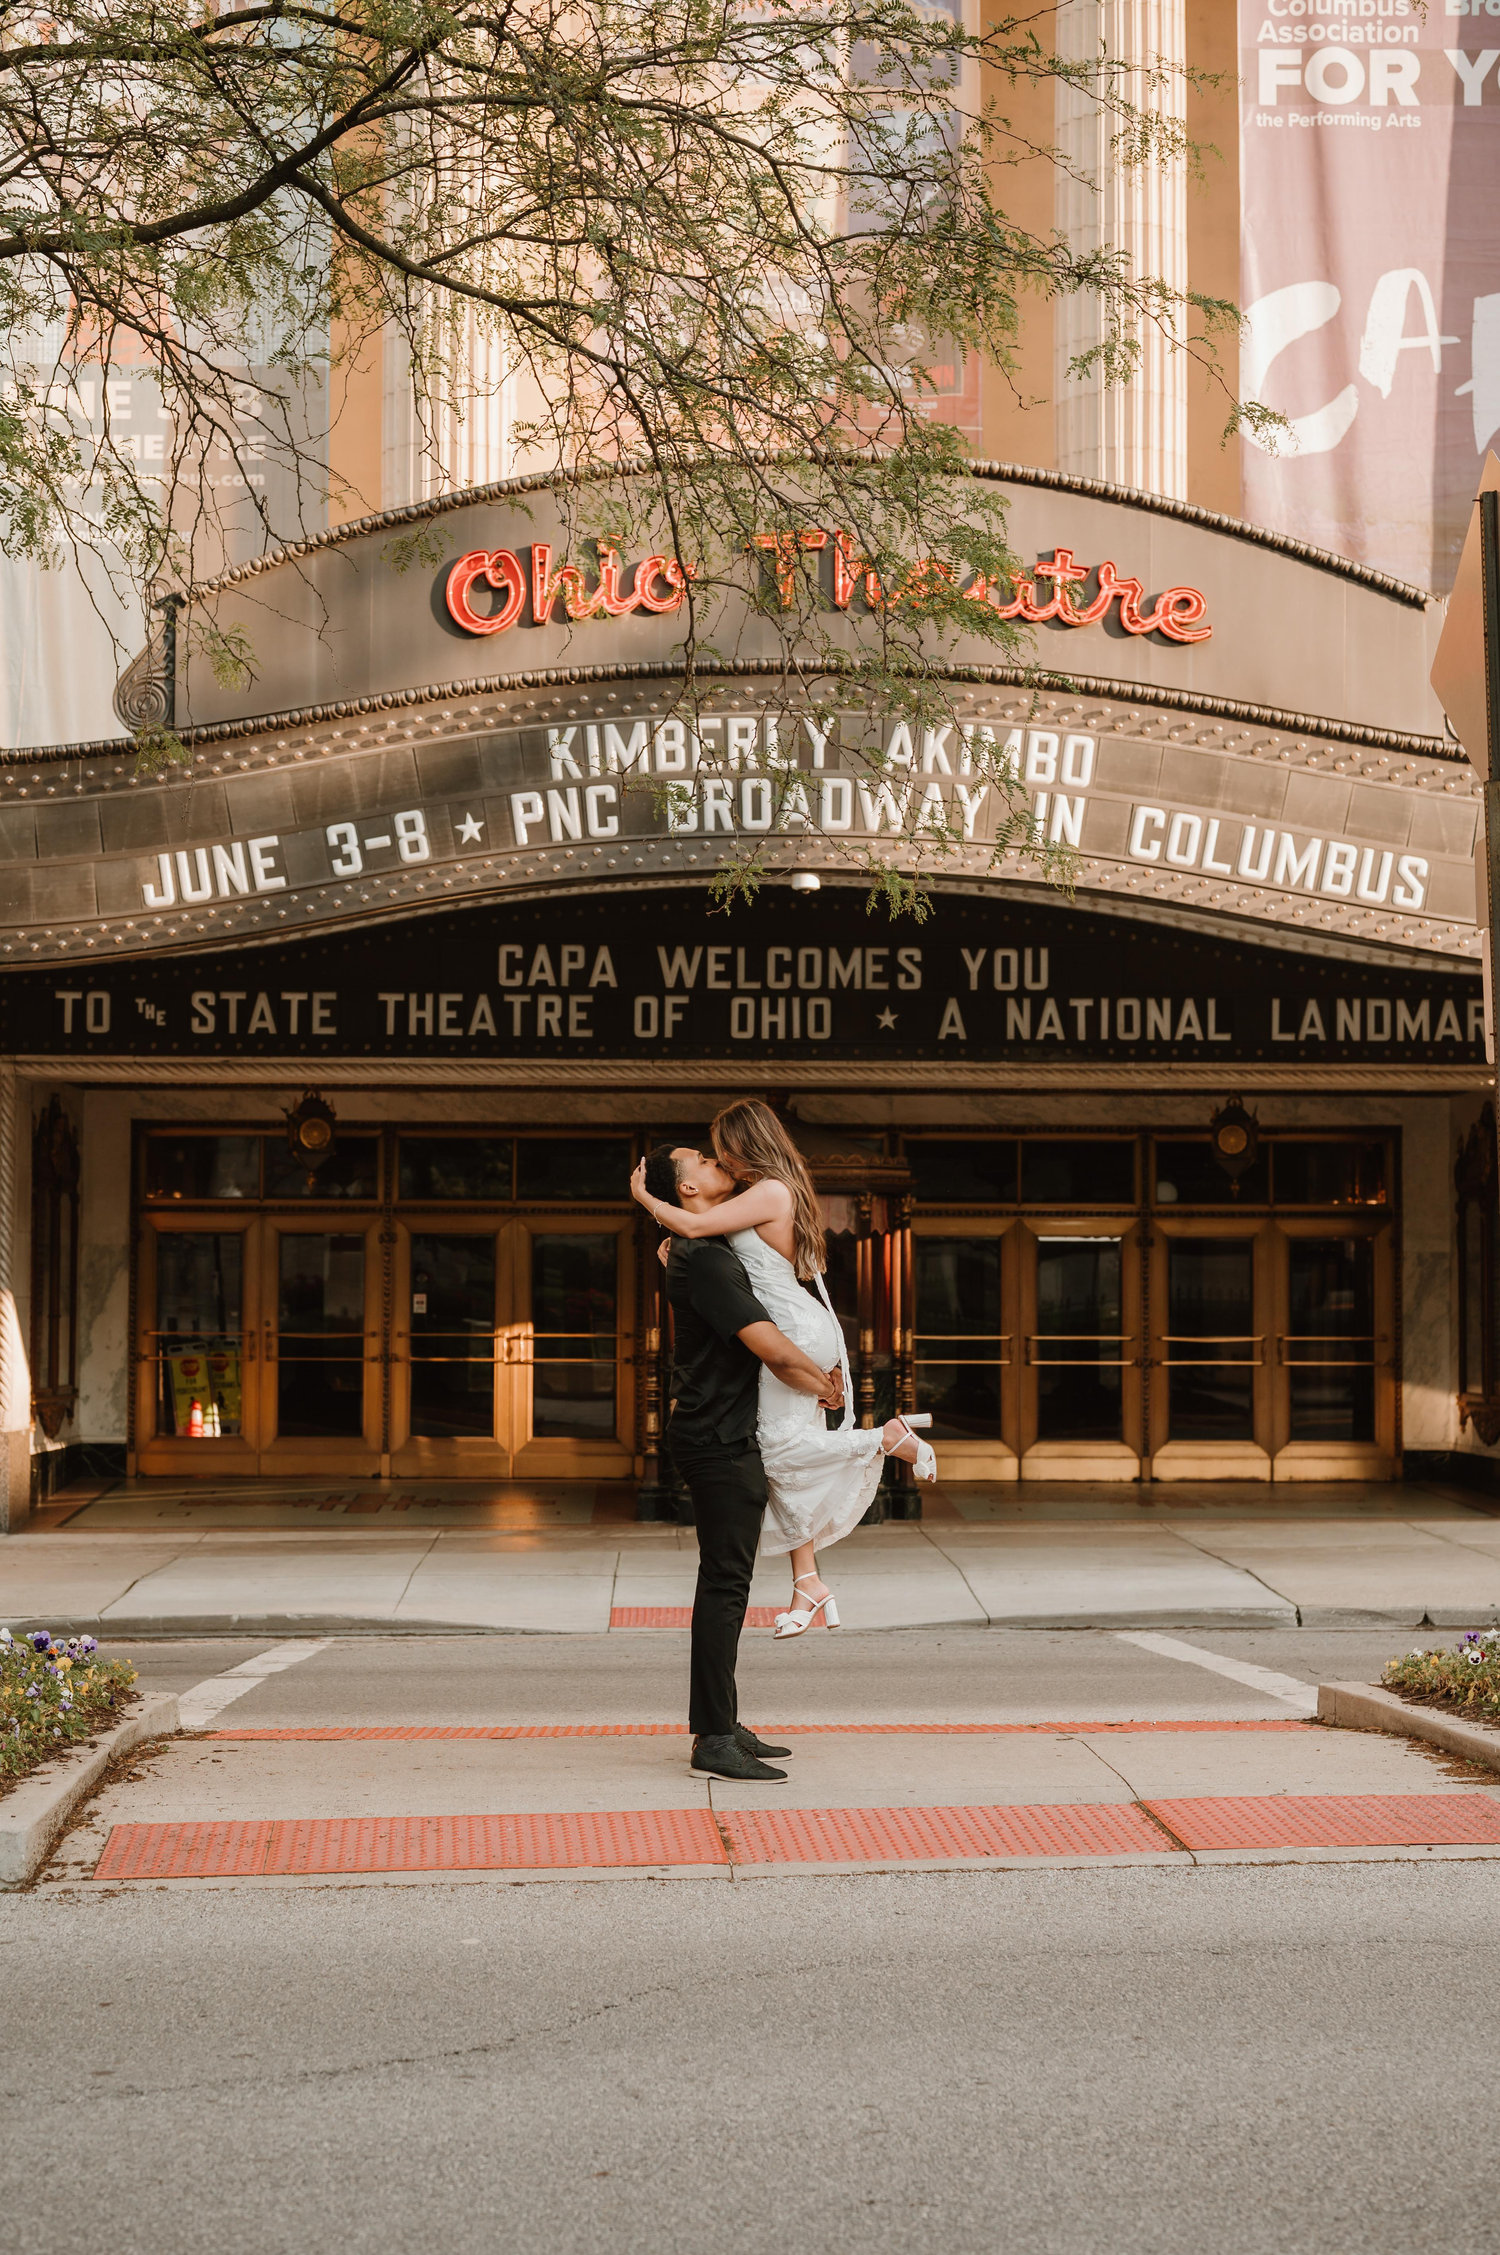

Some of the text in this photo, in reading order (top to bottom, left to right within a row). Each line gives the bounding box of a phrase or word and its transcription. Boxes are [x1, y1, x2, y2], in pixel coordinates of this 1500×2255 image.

[1257, 19, 1419, 43] Association
[1268, 0, 1409, 17] Columbus
[1258, 47, 1421, 106] FOR
[1256, 112, 1421, 130] the Performing Arts
[446, 533, 699, 635] Ohio
[547, 717, 1095, 788] KIMBERLY AKIMBO
[143, 776, 1429, 910] JUNE 3-8 PNC BROADWAY IN COLUMBUS
[498, 944, 1050, 991] CAPA WELCOMES YOU
[54, 991, 111, 1035] TO
[134, 997, 167, 1027] THE
[190, 991, 339, 1035] STATE
[377, 993, 594, 1038] THEATRE
[633, 996, 690, 1039] OF
[730, 997, 833, 1040] OHIO
[937, 997, 968, 1041] A
[1005, 997, 1233, 1042] NATIONAL
